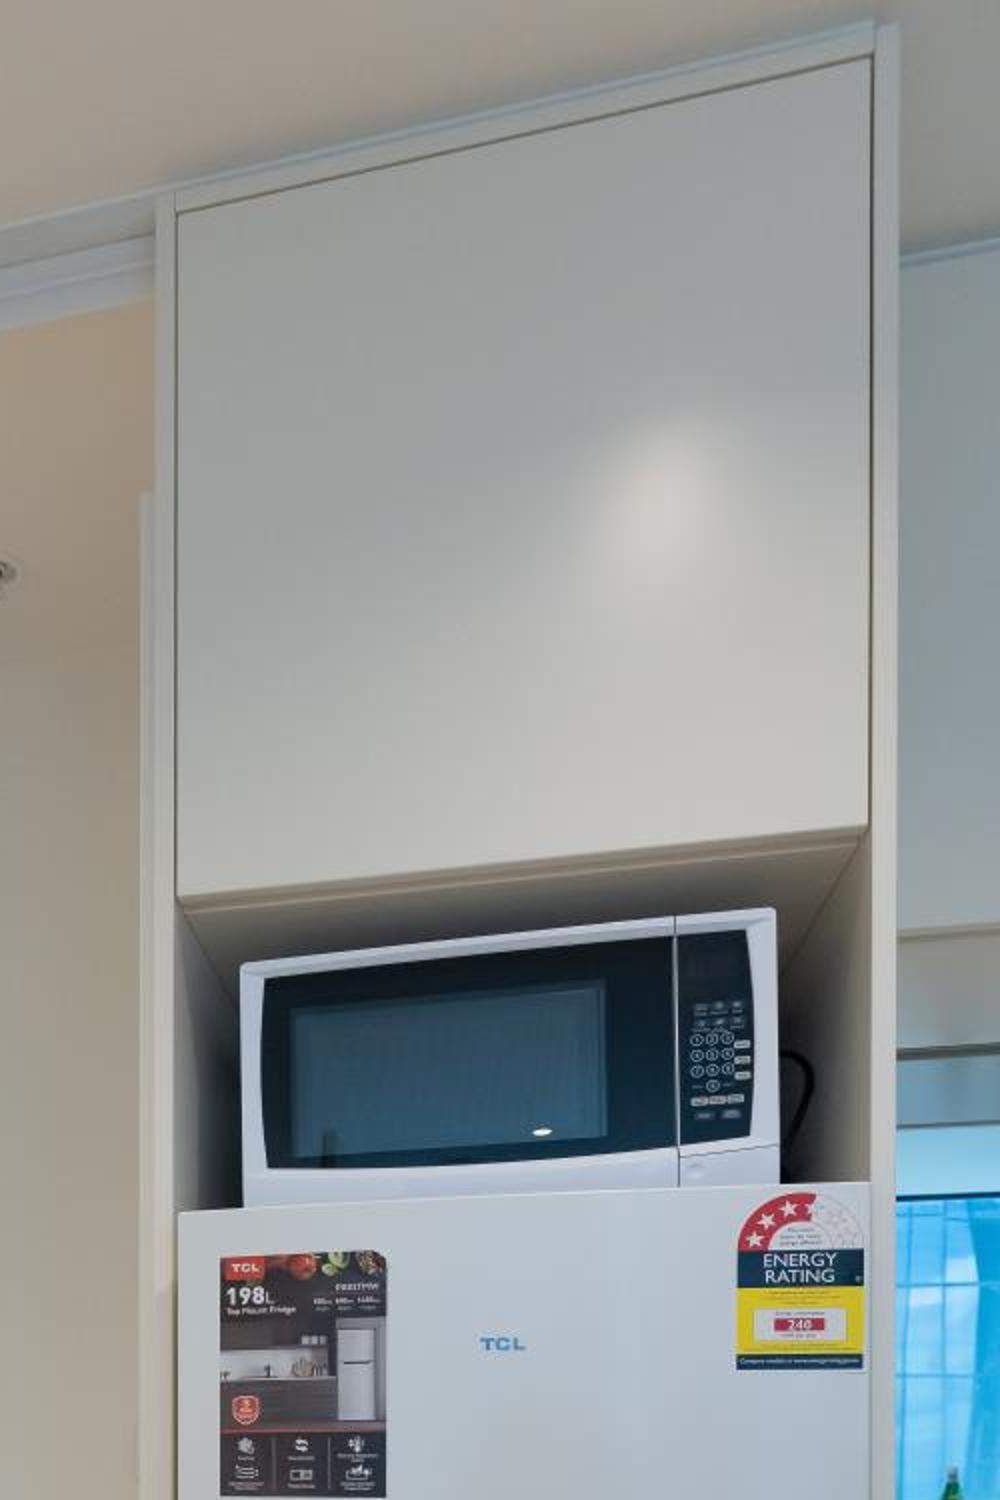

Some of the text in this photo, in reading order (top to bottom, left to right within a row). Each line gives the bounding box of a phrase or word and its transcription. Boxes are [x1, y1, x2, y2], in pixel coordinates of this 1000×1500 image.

[763, 1252, 837, 1268] ENERGY
[231, 1263, 260, 1273] TCL
[764, 1269, 836, 1284] RATING
[269, 1305, 297, 1316] Fridge
[479, 1337, 527, 1351] TCL
